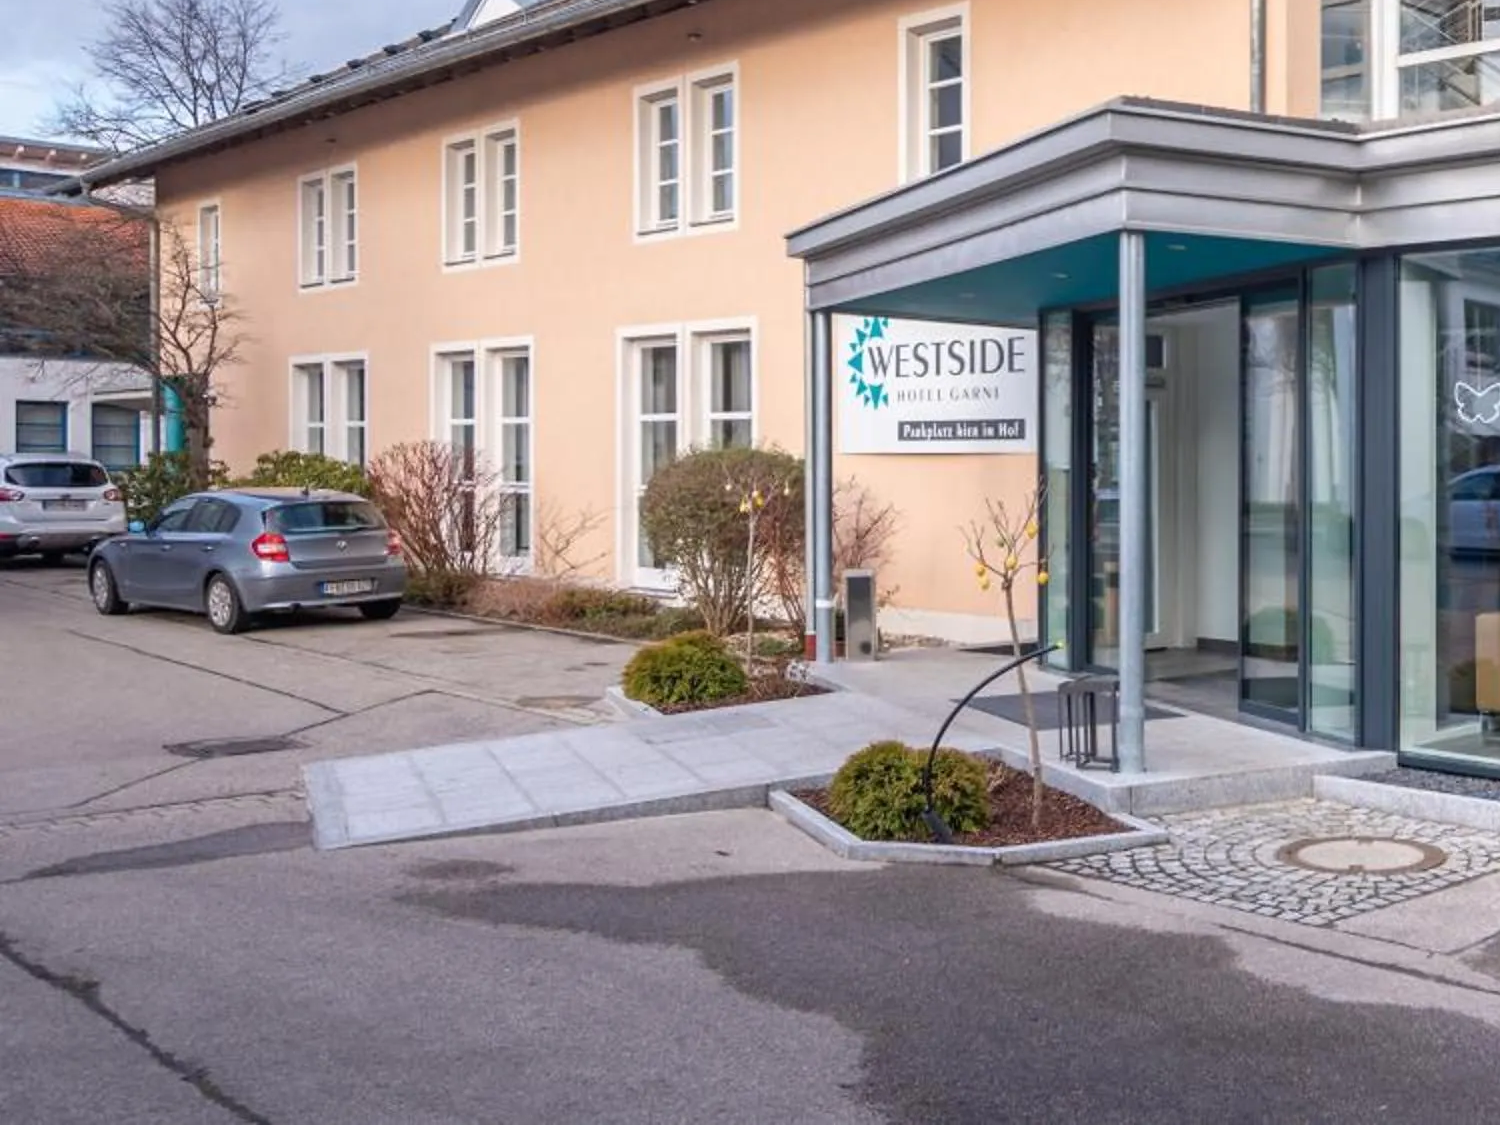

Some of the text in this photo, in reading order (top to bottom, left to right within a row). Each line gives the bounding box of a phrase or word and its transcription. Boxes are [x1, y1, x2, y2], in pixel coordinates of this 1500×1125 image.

[868, 337, 1025, 378] WESTSIDE
[897, 386, 999, 402] HOTEL GARNI
